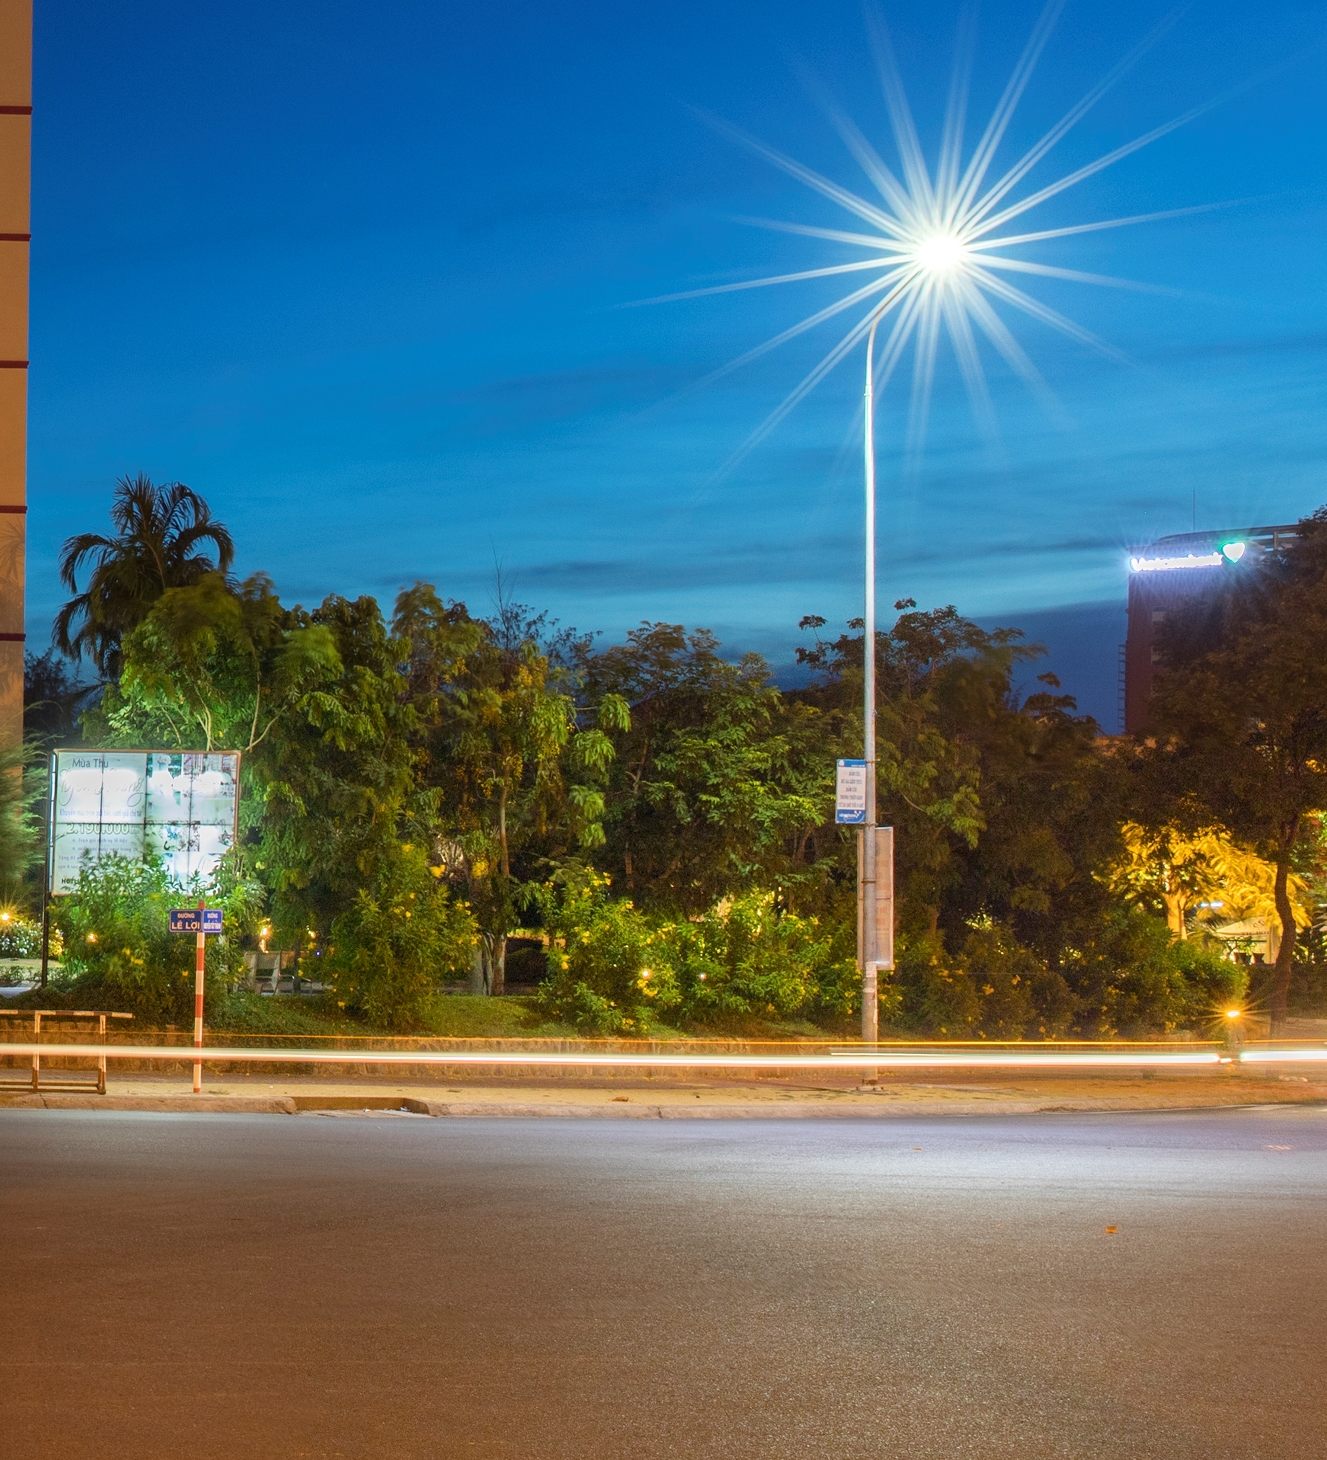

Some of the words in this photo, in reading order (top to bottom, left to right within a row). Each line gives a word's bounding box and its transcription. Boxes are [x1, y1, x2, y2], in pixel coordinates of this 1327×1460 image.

[71, 758, 91, 768] Mùa
[93, 758, 109, 768] Thu
[171, 919, 183, 930] LÊ
[185, 920, 201, 931] LỢI
